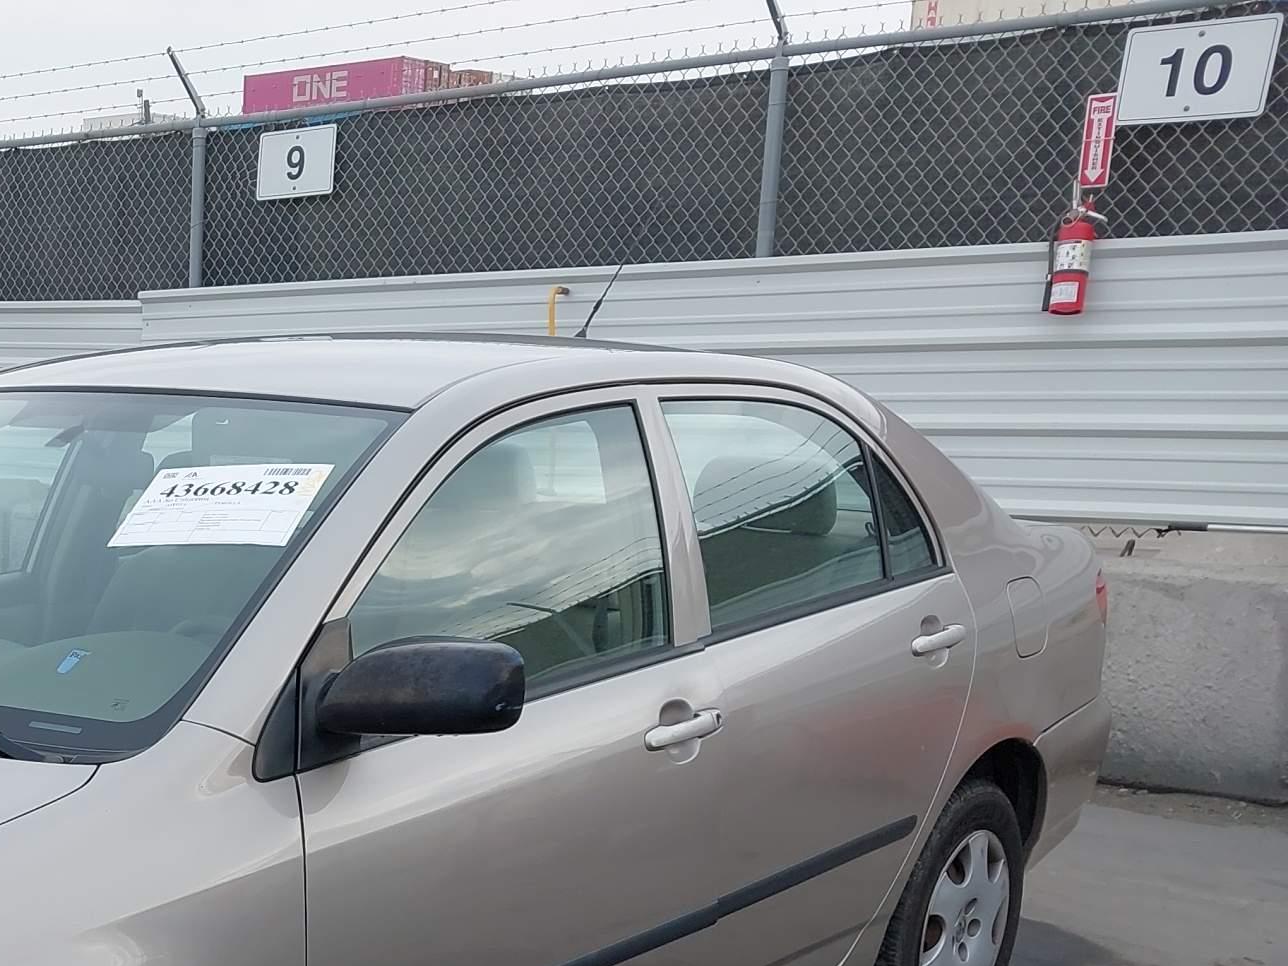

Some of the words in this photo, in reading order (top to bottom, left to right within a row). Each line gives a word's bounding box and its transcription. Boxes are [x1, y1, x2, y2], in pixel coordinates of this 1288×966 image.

[1160, 44, 1233, 97] 10
[293, 71, 348, 102] ONE
[1092, 105, 1111, 115] FIRE
[286, 145, 305, 181] 9
[160, 480, 299, 498] 43668428
